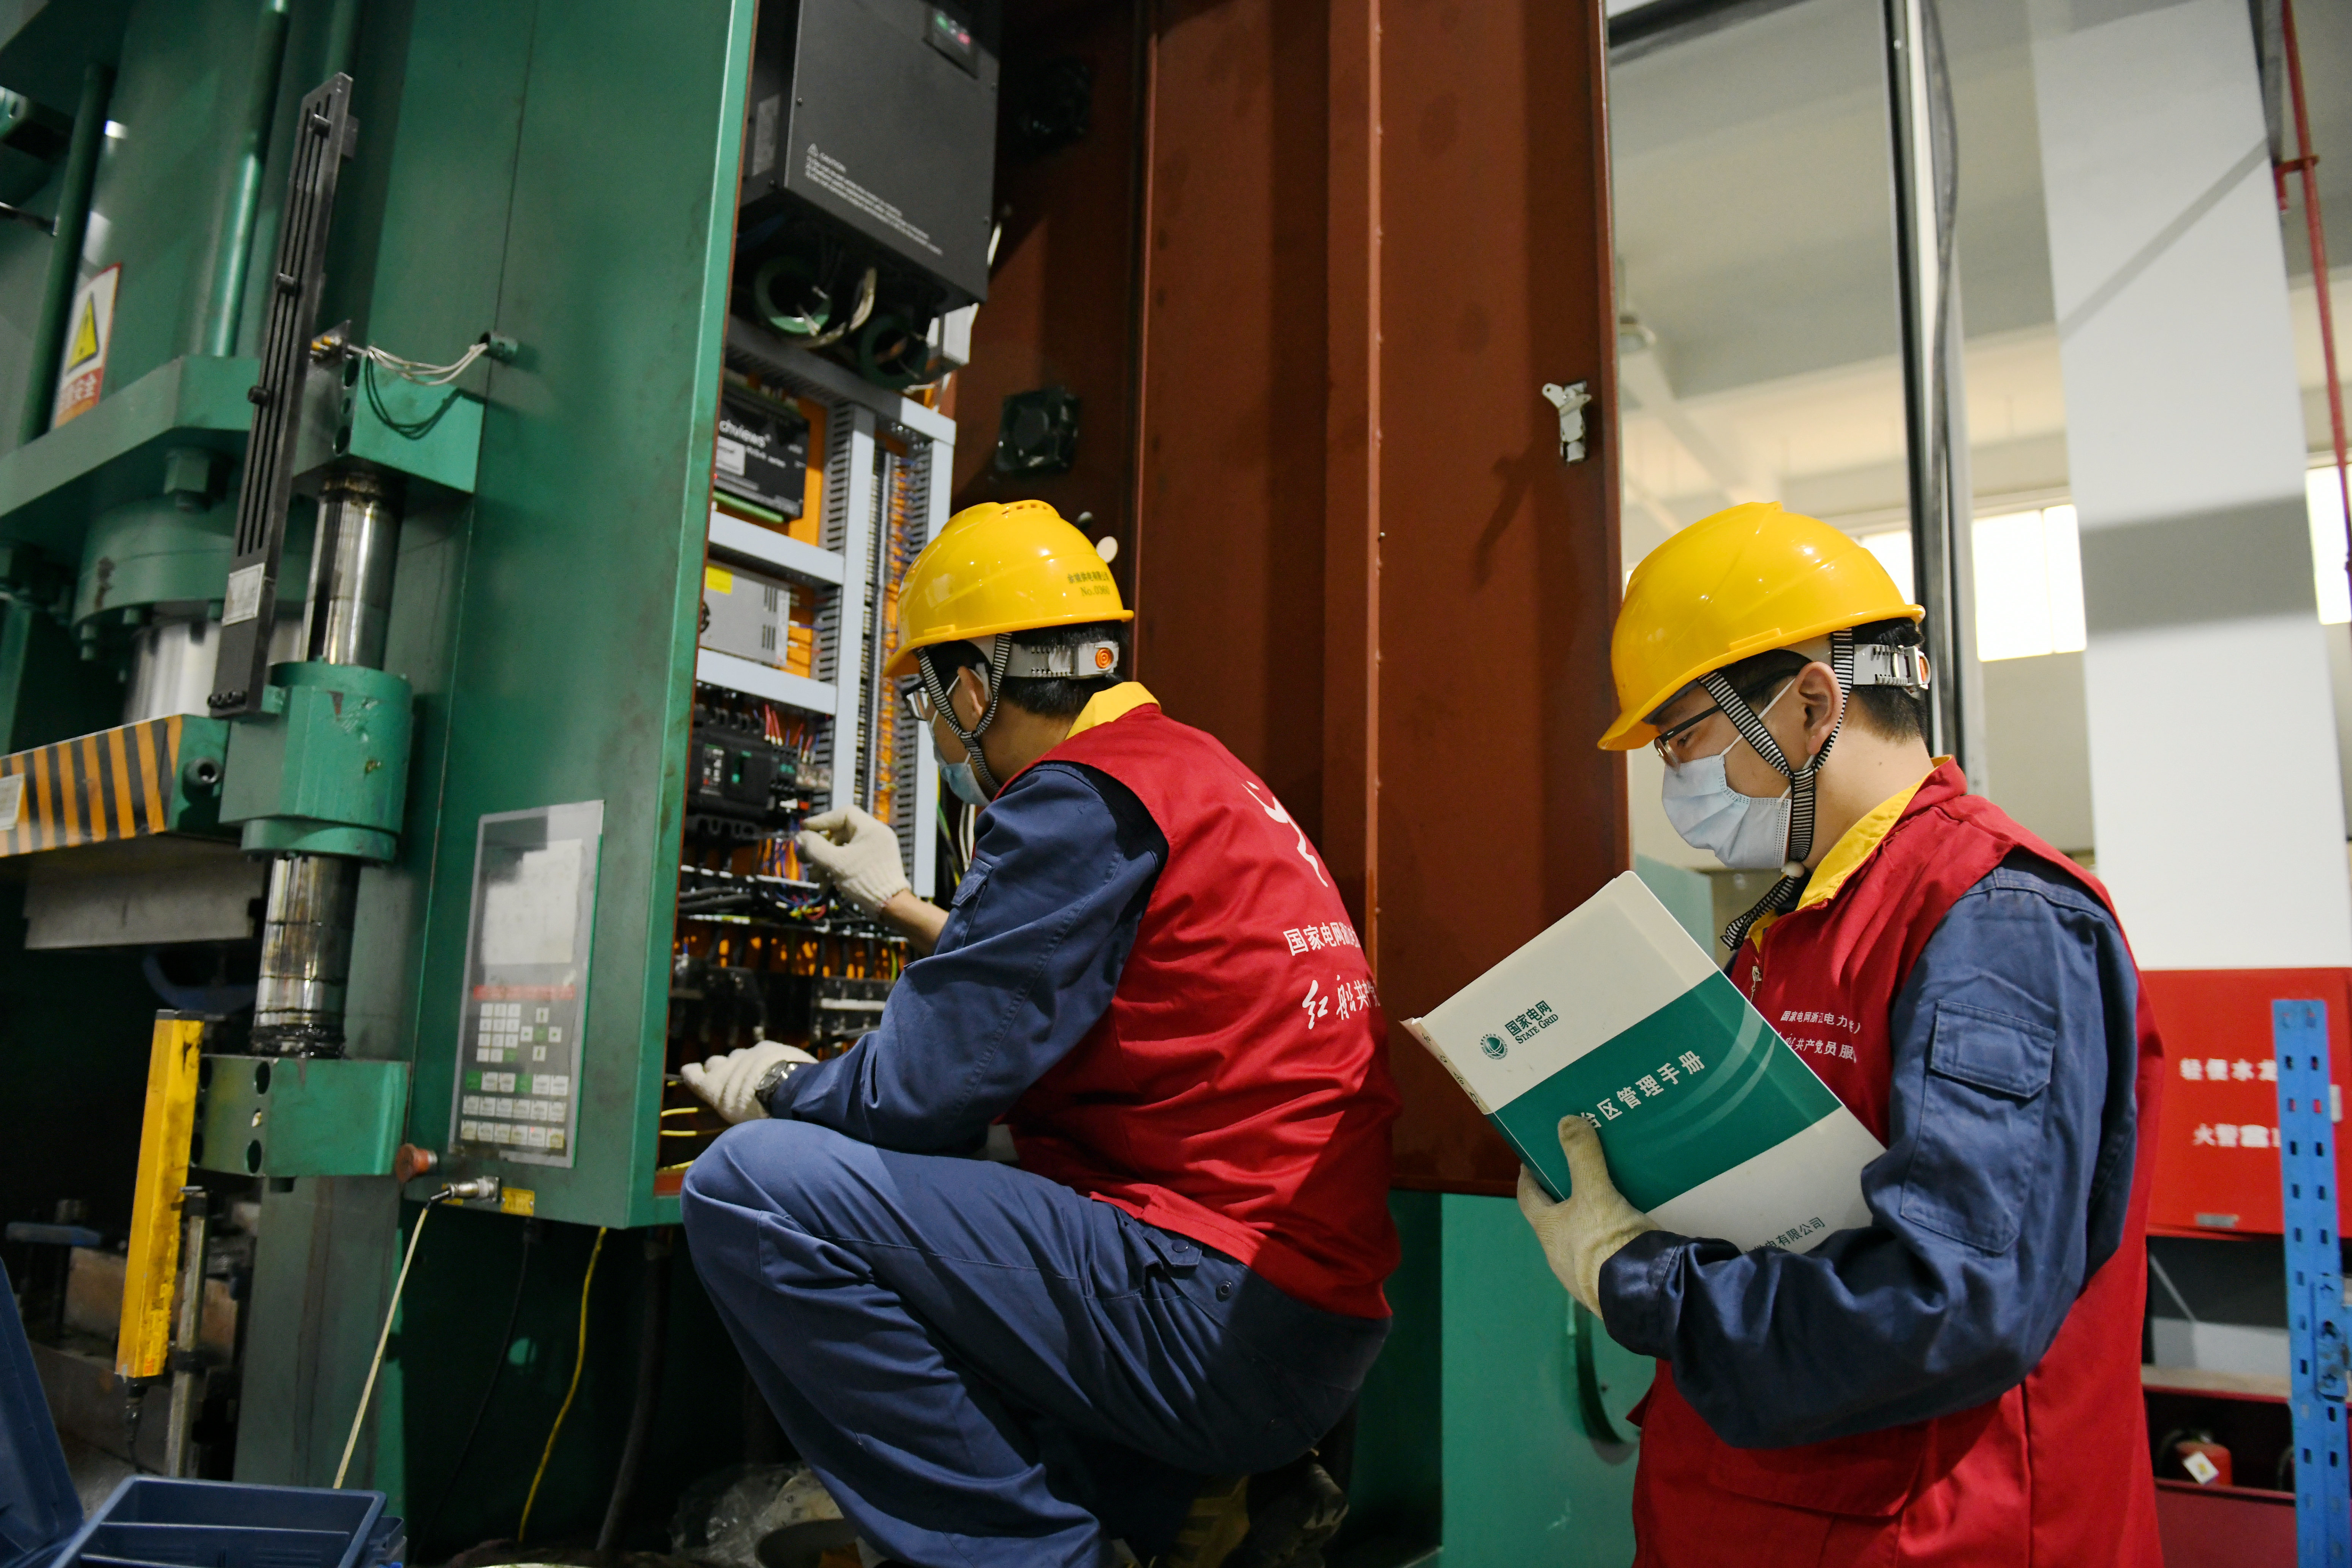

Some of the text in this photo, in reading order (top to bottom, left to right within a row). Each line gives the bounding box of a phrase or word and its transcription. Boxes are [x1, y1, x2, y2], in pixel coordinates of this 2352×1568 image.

[1505, 1000, 1552, 1036] 国家电网
[1515, 1014, 1558, 1044] STATE GRID
